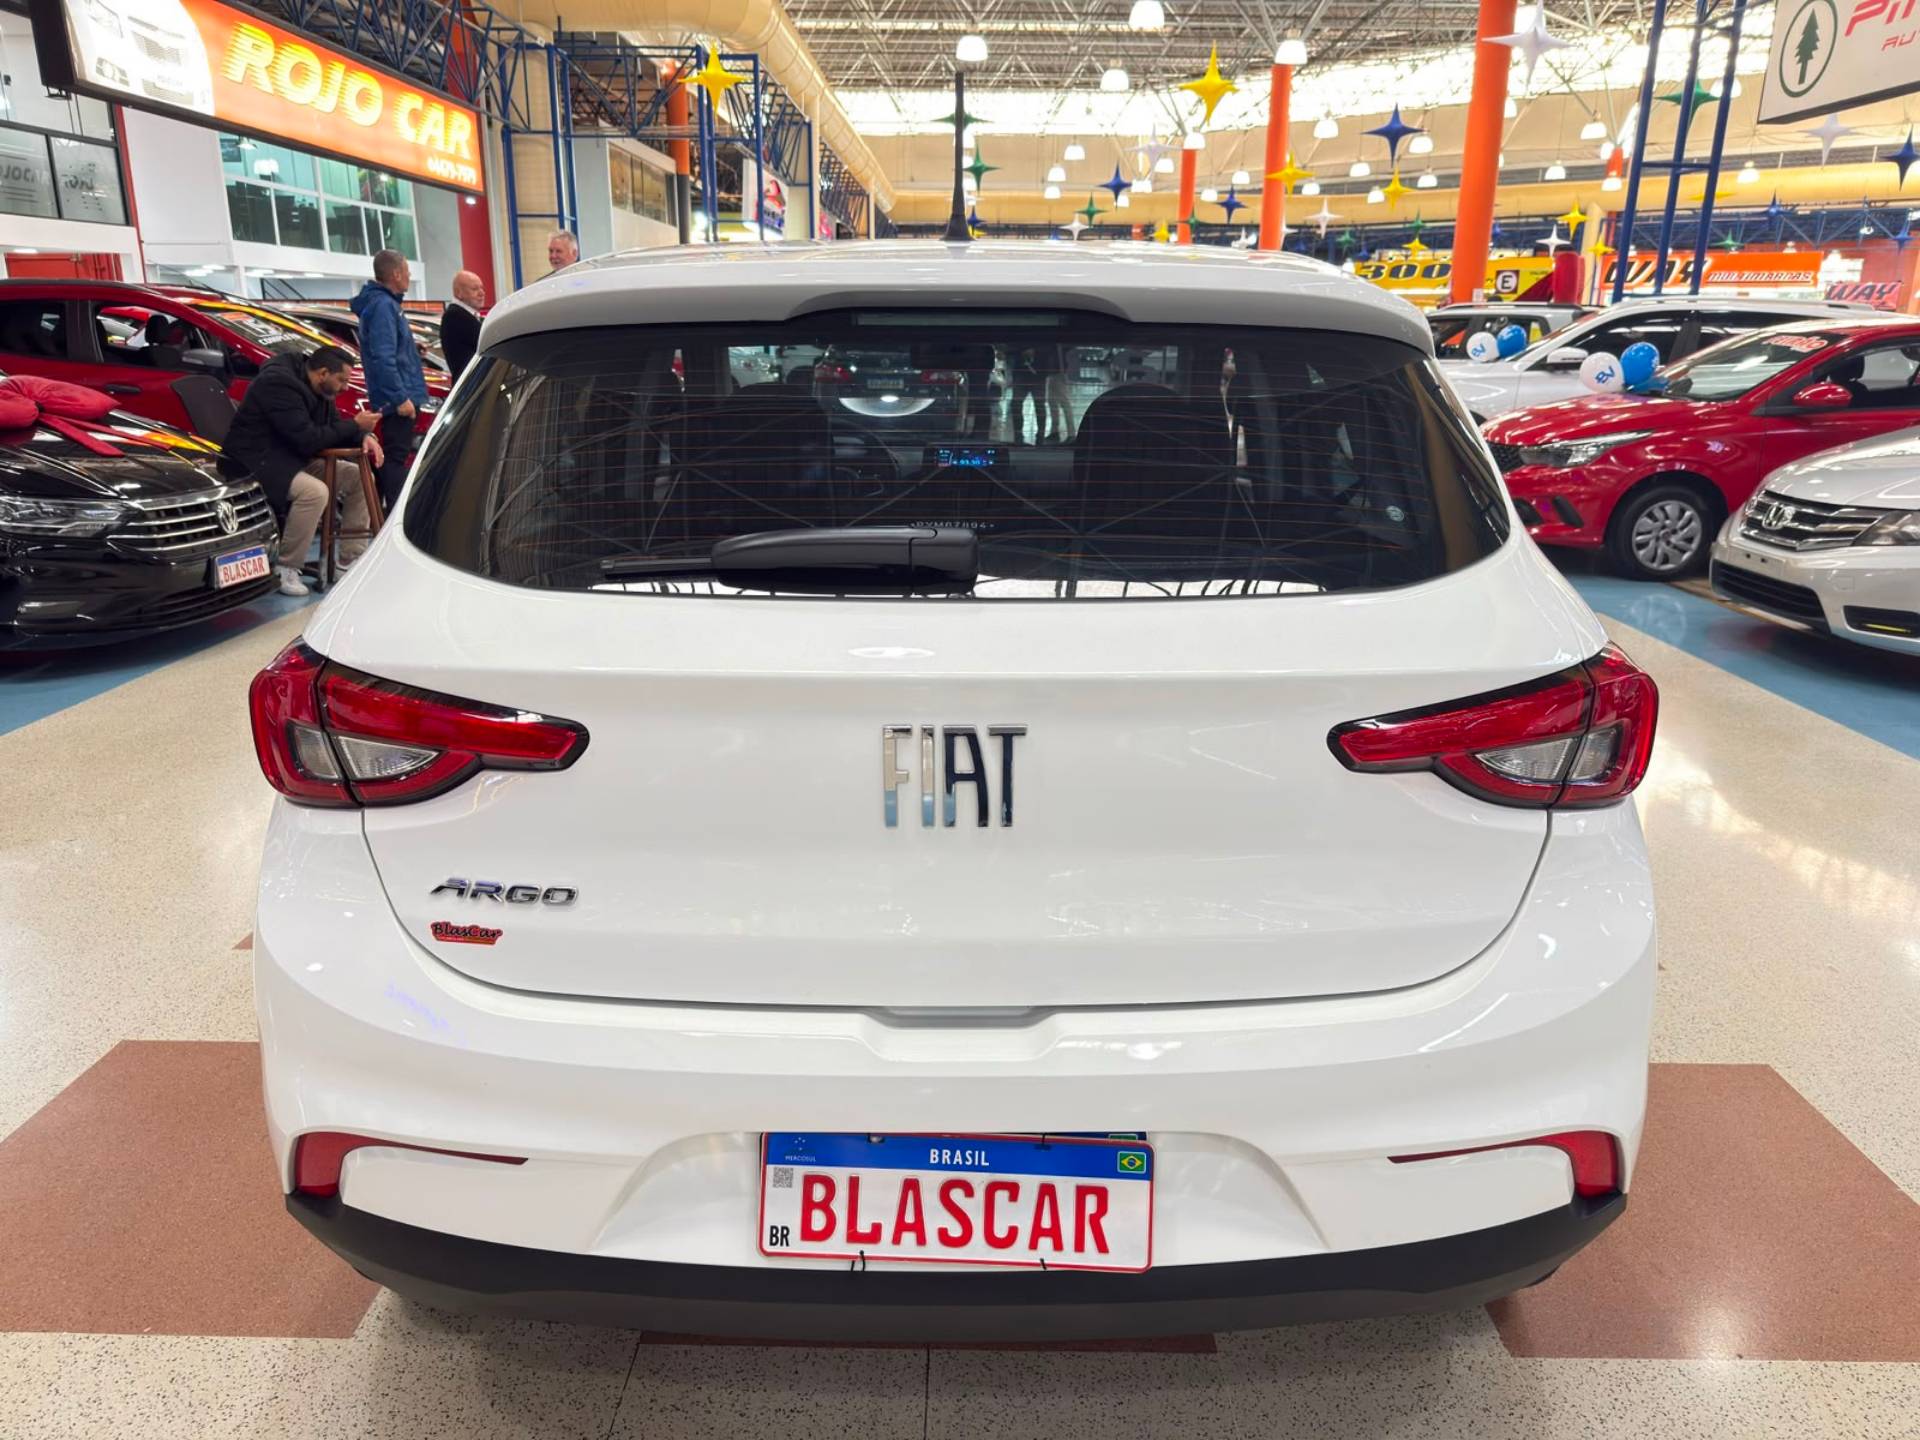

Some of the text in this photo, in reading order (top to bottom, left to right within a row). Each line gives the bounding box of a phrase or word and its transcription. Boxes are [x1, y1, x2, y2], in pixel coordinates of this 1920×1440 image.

[1881, 30, 1920, 51] AU
[222, 21, 472, 160] ROJO CAR
[1824, 283, 1898, 301] WAY
[1594, 365, 1616, 384] BV
[222, 557, 265, 583] BLASCAR
[883, 723, 1028, 828] FIAT
[430, 877, 578, 907] ARGO
[431, 920, 503, 939] BlasCar
[928, 1147, 990, 1168] BRASIL
[800, 1173, 1111, 1255] BLASCAR
[768, 1224, 791, 1248] BR
